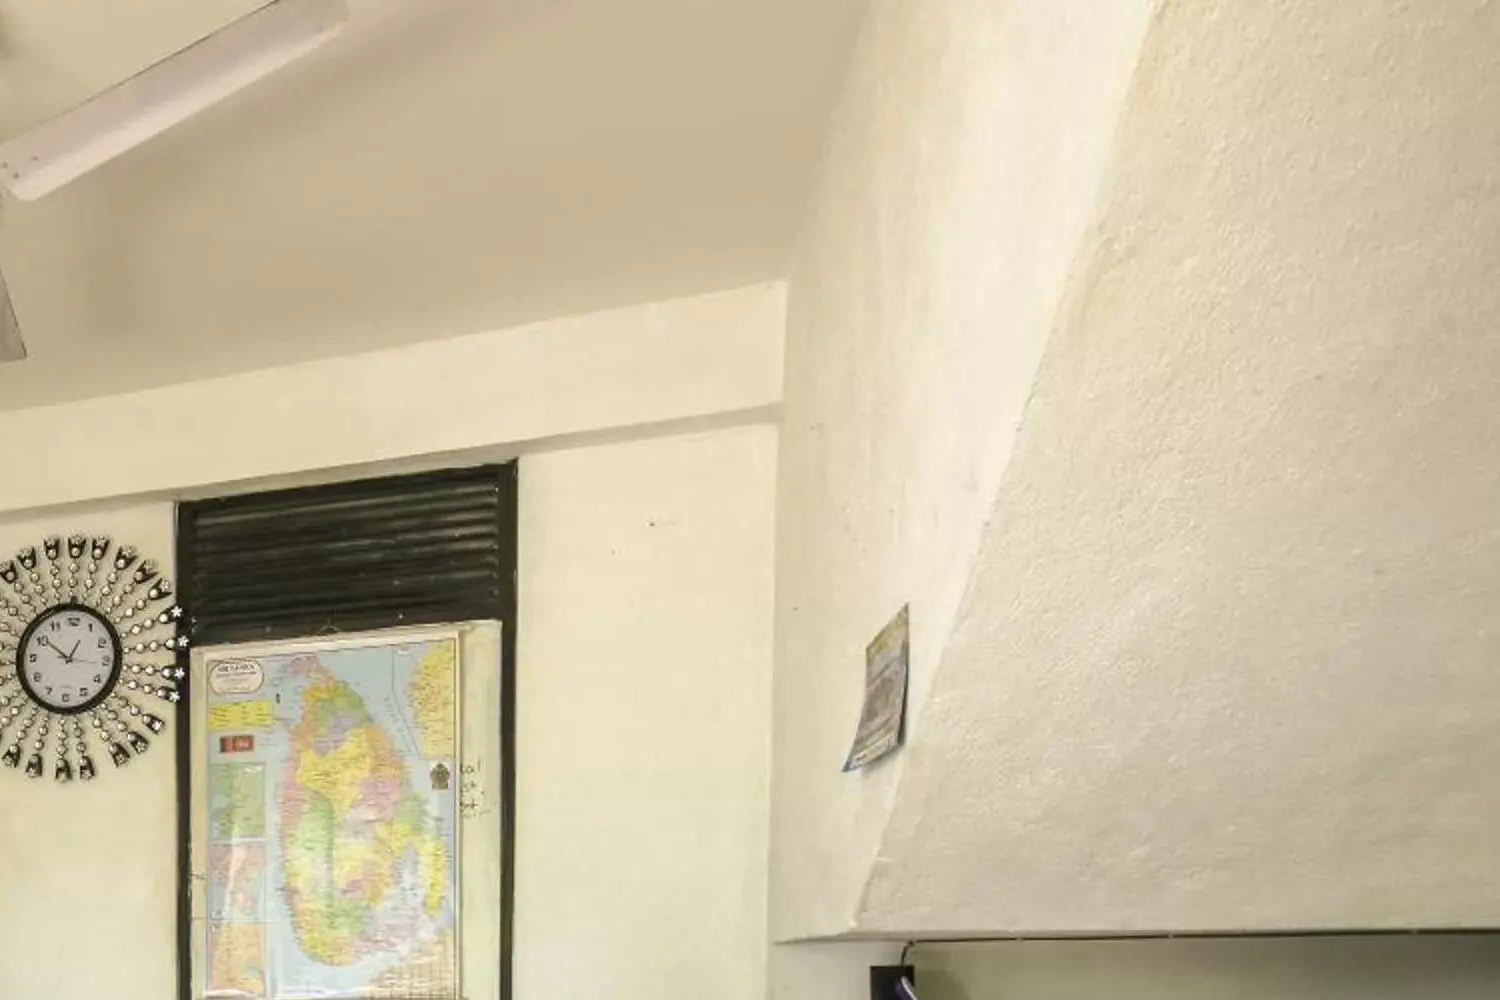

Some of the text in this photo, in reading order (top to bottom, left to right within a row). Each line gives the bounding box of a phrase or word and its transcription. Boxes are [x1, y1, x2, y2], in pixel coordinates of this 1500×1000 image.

[36, 635, 49, 647] 10
[98, 638, 107, 649] 2
[93, 673, 101, 684] 4
[45, 686, 53, 696] 7
